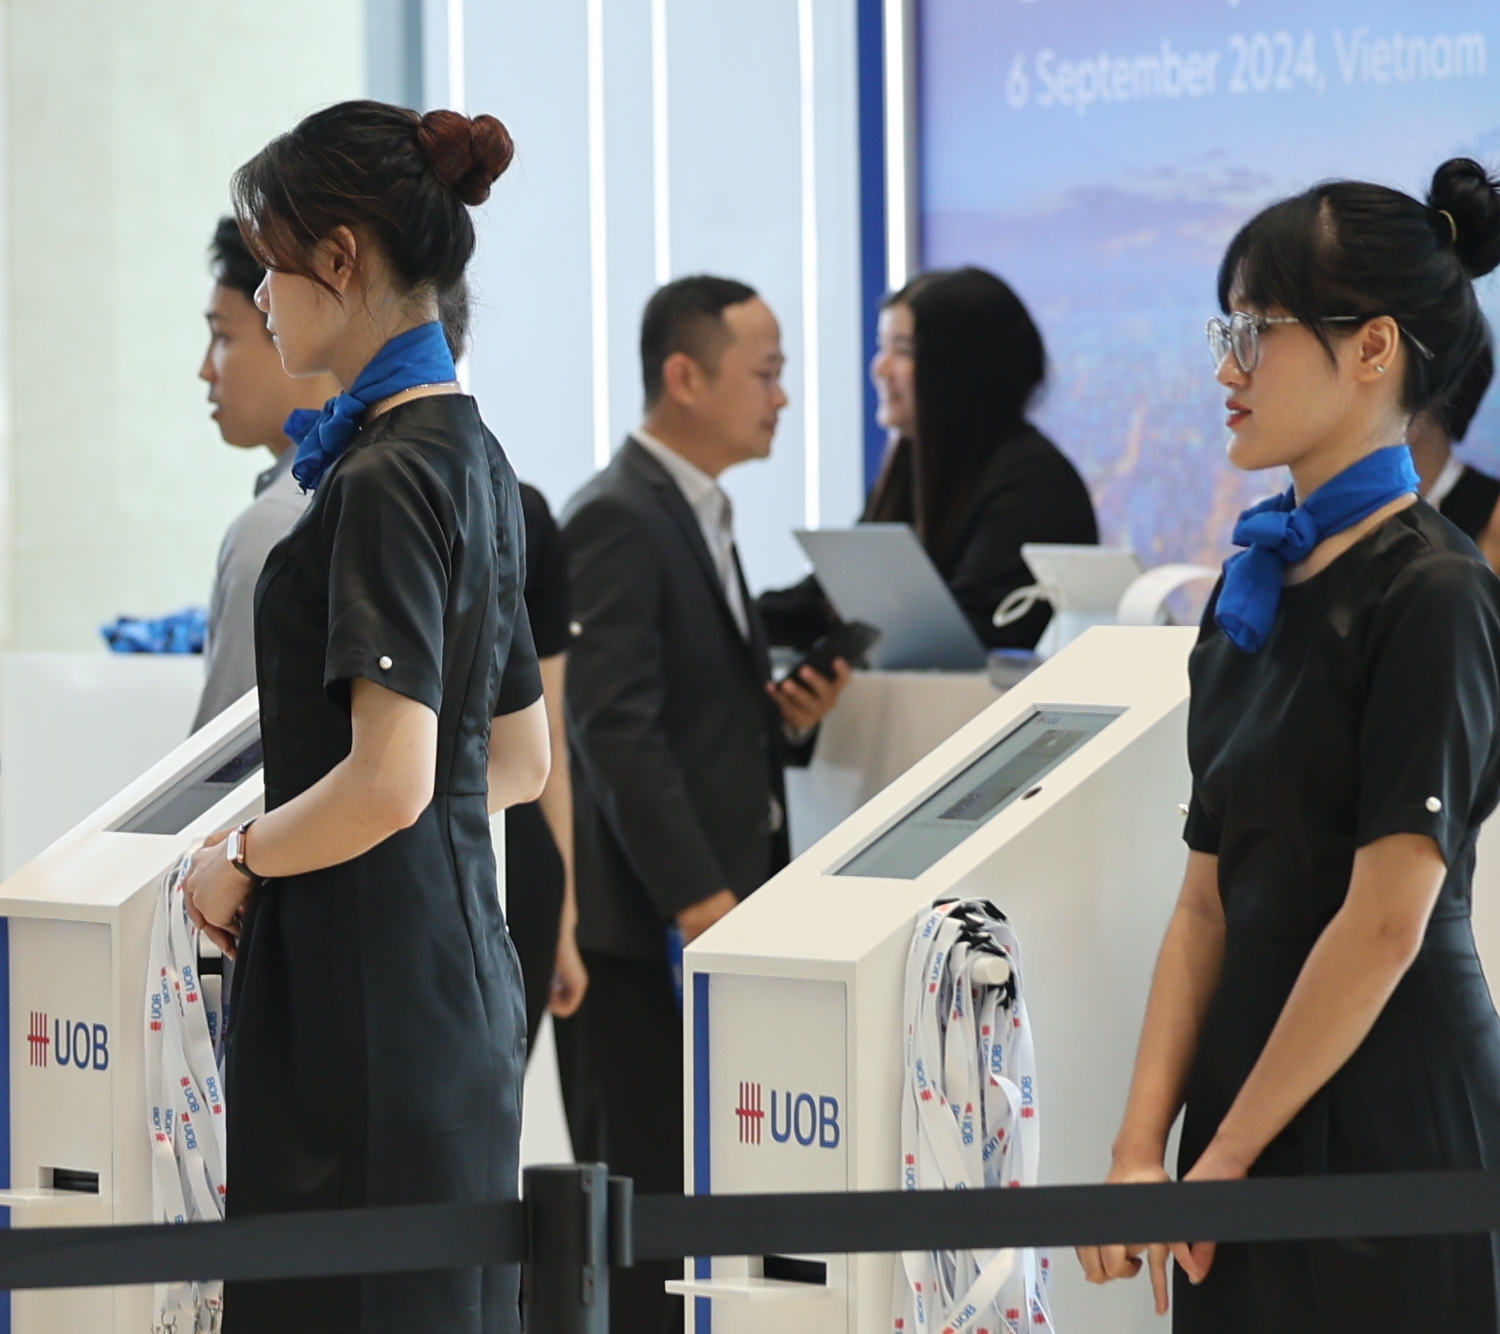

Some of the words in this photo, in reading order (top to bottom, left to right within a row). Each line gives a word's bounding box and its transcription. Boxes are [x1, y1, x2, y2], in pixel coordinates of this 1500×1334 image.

[1003, 50, 1031, 111] 6
[1034, 37, 1221, 118] September
[1226, 30, 1327, 97] 2024,
[1332, 24, 1487, 87] Vietnam
[182, 964, 195, 992] UOB
[931, 951, 945, 981] UOB
[162, 978, 171, 1005] UOB
[151, 993, 162, 1019] UOB
[55, 1018, 110, 1072] UOB
[991, 1043, 1003, 1074] UOB
[916, 1058, 928, 1089] UOB
[184, 1087, 200, 1114] UOB
[206, 1076, 220, 1104] UOB
[1021, 1075, 1034, 1106] UOB
[153, 1106, 162, 1131] UOB
[164, 1108, 174, 1135] UOB
[771, 1089, 841, 1149] UOB
[961, 1116, 974, 1146] UOB
[184, 1123, 197, 1150] UOB
[952, 1304, 977, 1330] UOB
